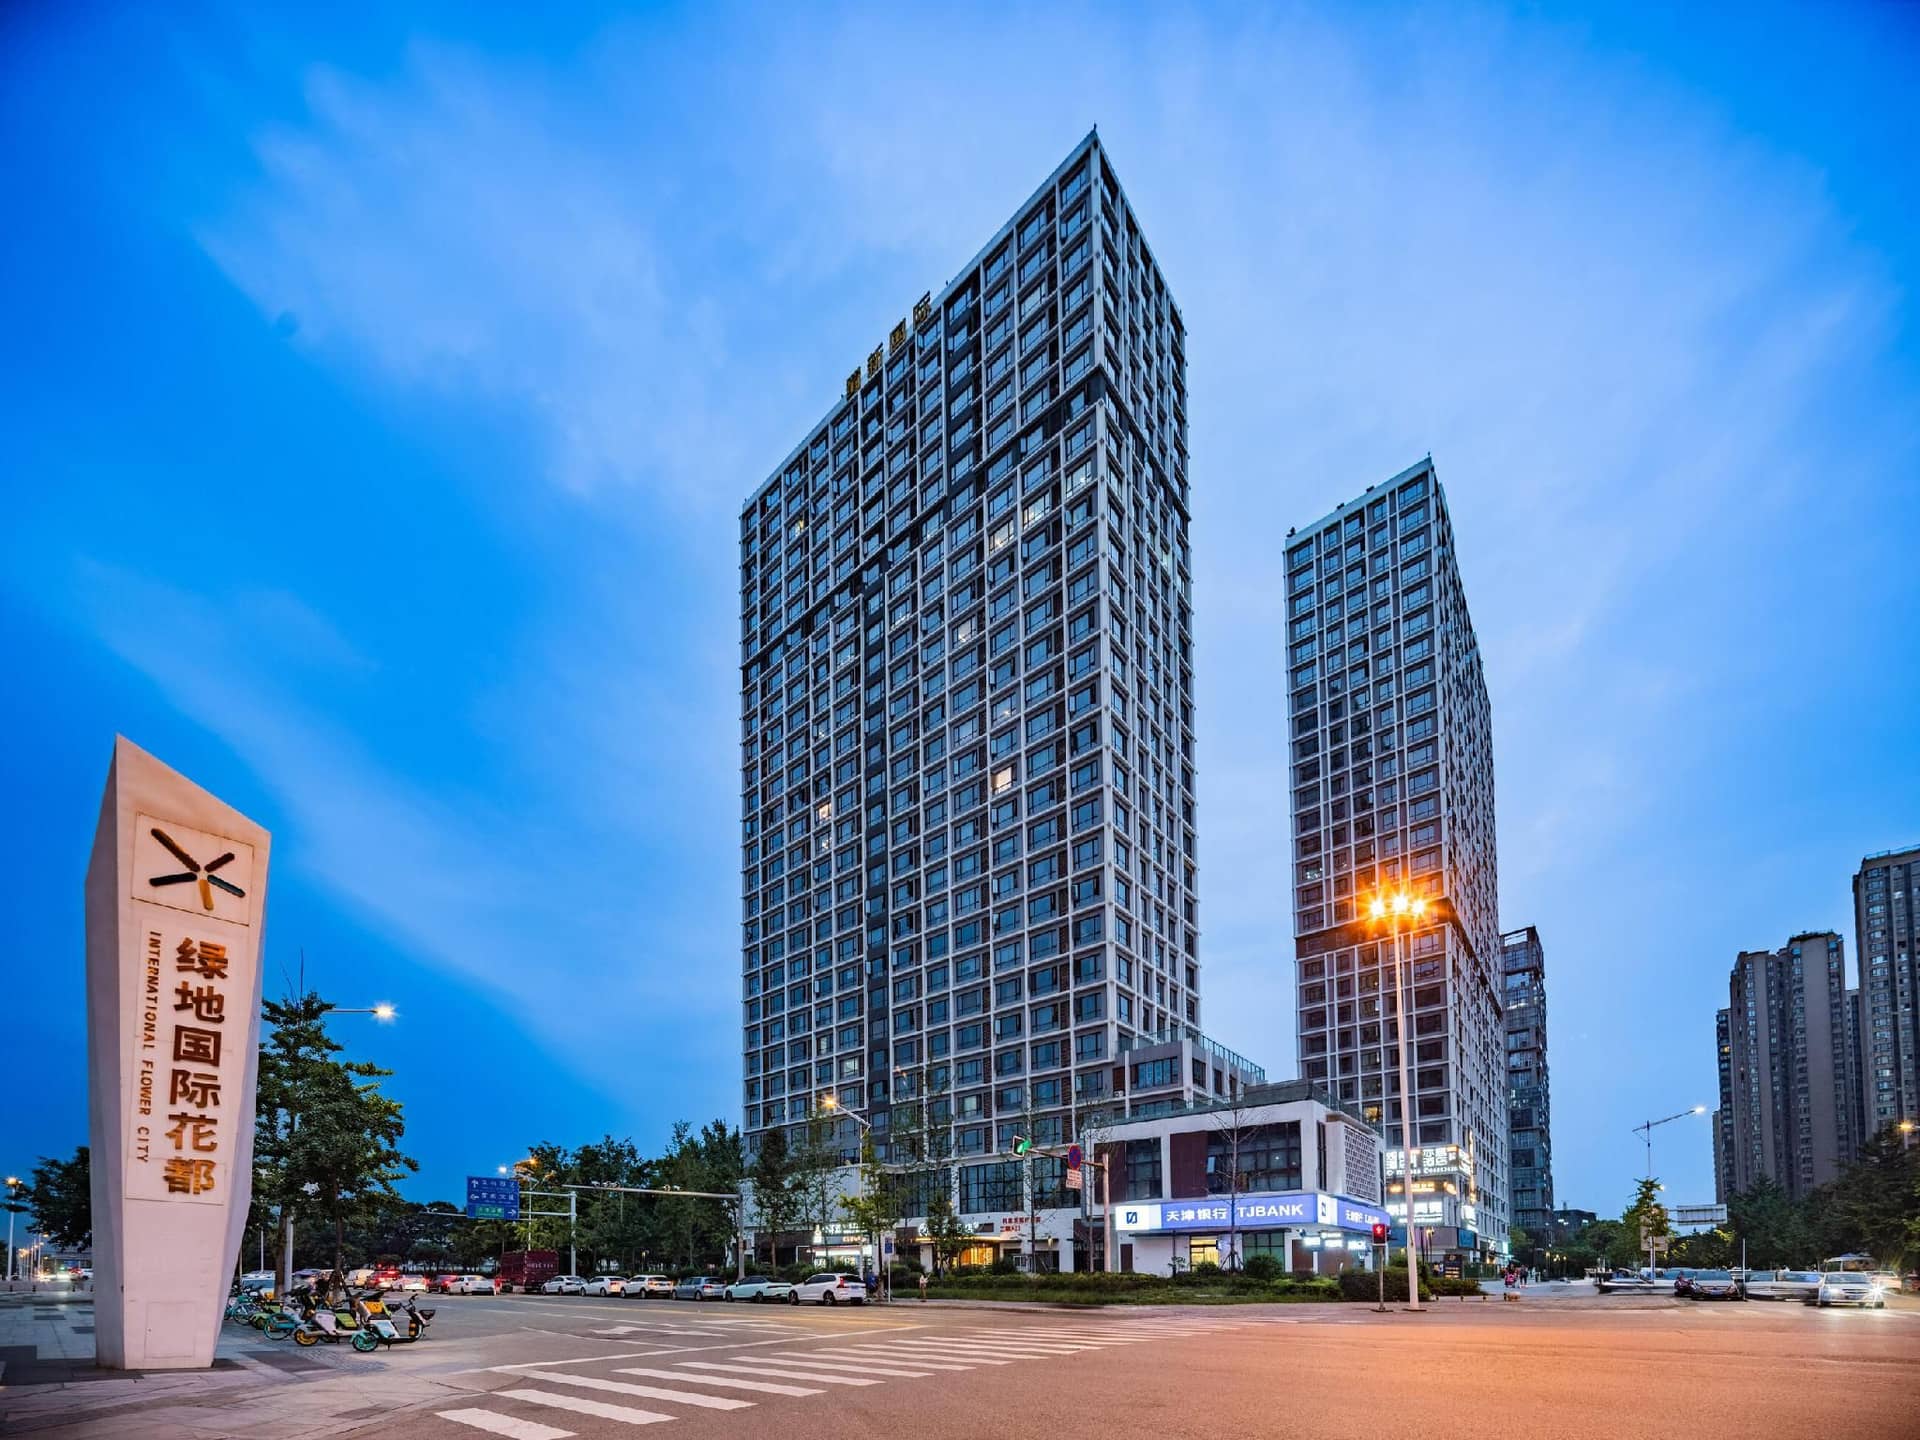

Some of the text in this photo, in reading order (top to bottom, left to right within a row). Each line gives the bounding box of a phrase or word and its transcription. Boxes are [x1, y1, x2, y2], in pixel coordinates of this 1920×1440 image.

[136, 931, 162, 1163] INTERNATIONAL FLOWER CITY
[162, 936, 229, 1195] 绿地国际花都
[1166, 1204, 1304, 1222] 天津银行 TJBANK
